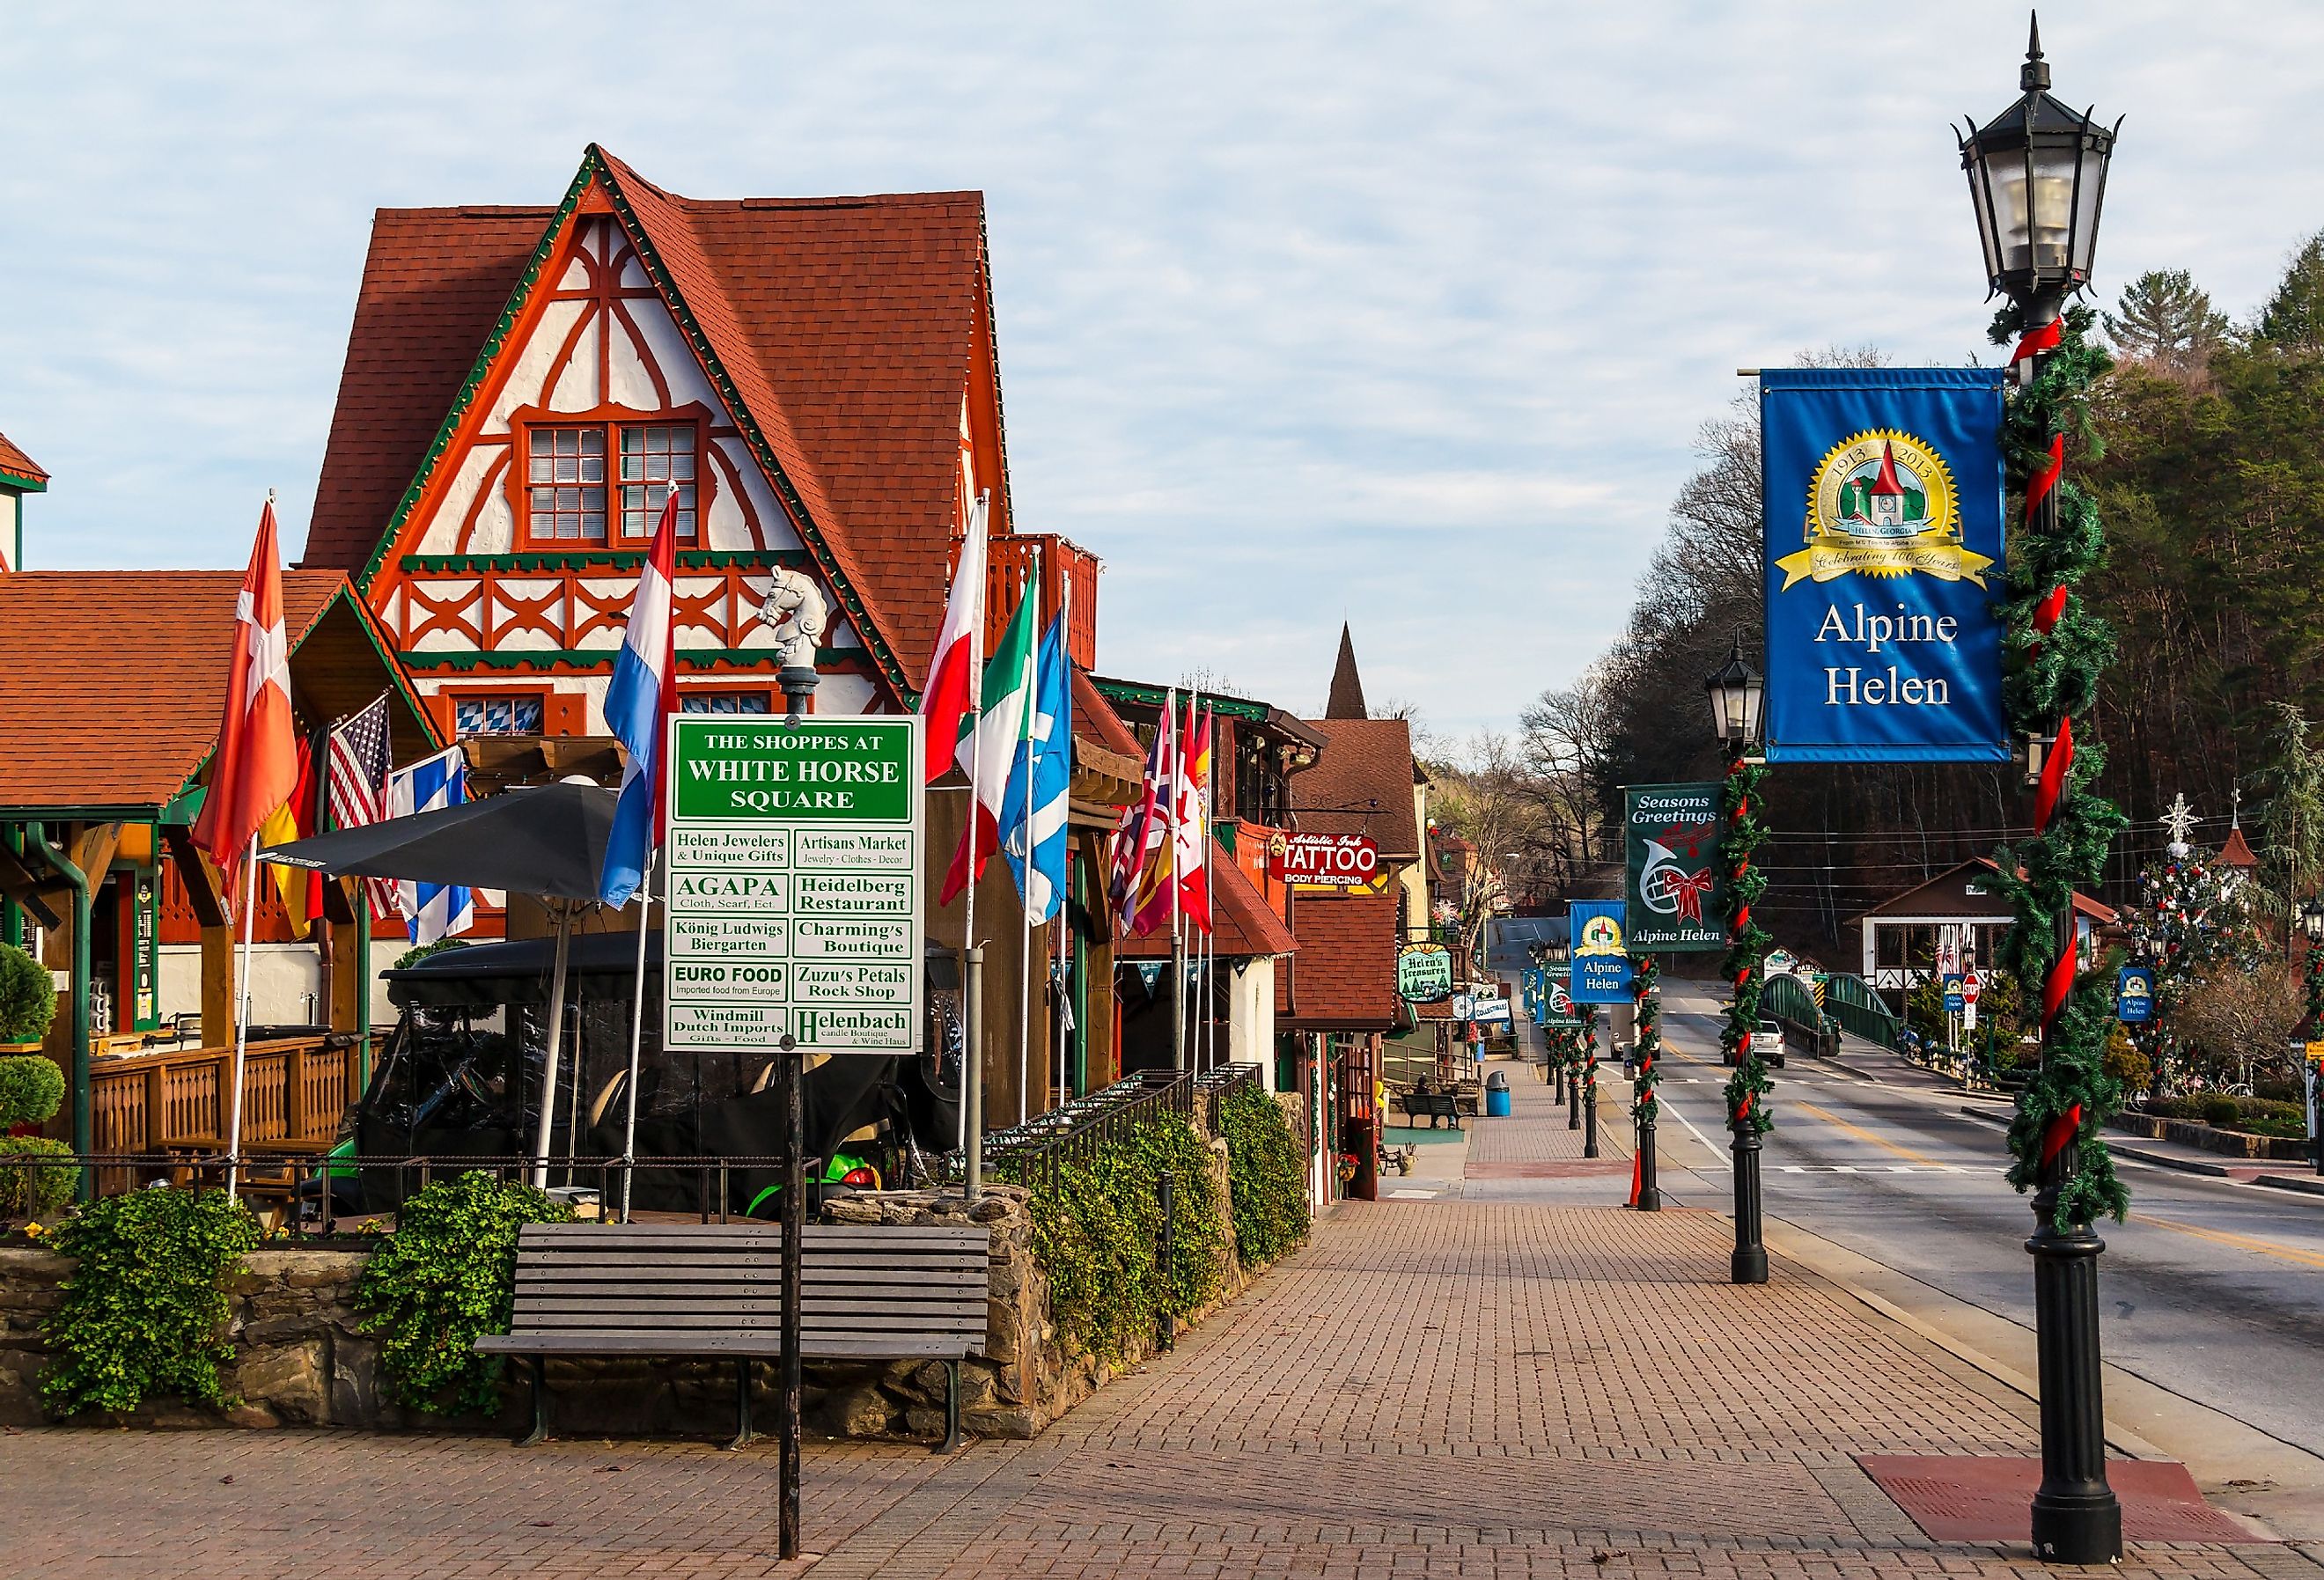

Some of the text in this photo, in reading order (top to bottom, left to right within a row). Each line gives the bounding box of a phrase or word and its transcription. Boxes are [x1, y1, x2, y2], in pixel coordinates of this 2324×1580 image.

[1833, 447, 1866, 477] 1913
[1897, 447, 1933, 479] 2013
[1815, 549, 1960, 570] Celebrating 100 Years
[1814, 603, 1958, 653] Alpine
[1823, 665, 1950, 705] Helen
[705, 734, 883, 751] THE SHOPPES AT
[688, 759, 900, 784] WHITE HORSE
[731, 790, 855, 812] SQUARE
[1637, 795, 1710, 809] Seasons
[1631, 809, 1717, 825] Greetings
[677, 833, 785, 849] Helen Jewelers
[800, 836, 908, 851] Artisans Market
[1289, 834, 1362, 846] Artistic Ink
[677, 850, 784, 863] & Unique Gifts
[803, 854, 835, 865] Jewelry
[841, 855, 872, 864] Clothes
[879, 856, 903, 864] Decor
[1283, 845, 1375, 871] TATTOO
[675, 878, 780, 896] AGAPA
[800, 878, 906, 896] Heidelberg
[1284, 873, 1363, 885] BODY PIERCING
[680, 899, 776, 909] Cloth, Scarf, Ect.
[799, 895, 906, 911] Restaurant
[675, 922, 783, 938] König Ludwigs
[798, 922, 903, 940] Charming's
[1632, 928, 1720, 944] Alpine Helen
[690, 937, 767, 953] Biergarten
[823, 940, 904, 955] Boutique
[1407, 958, 1443, 969] Helen's
[1584, 961, 1622, 976] Alpine
[675, 967, 782, 982] EURO FOOD
[798, 967, 906, 983] Zuzu's Petals
[1401, 967, 1446, 980] Treasures
[676, 985, 780, 996] Imported food from Europe
[1585, 978, 1619, 989] Helen
[1965, 983, 1979, 996] STOP
[808, 985, 895, 1000] Rock Shop
[694, 1010, 764, 1022] Windmill
[673, 1022, 783, 1035] Dutch Imports
[797, 1011, 906, 1042] Helenbach
[850, 1030, 888, 1039] Boutique
